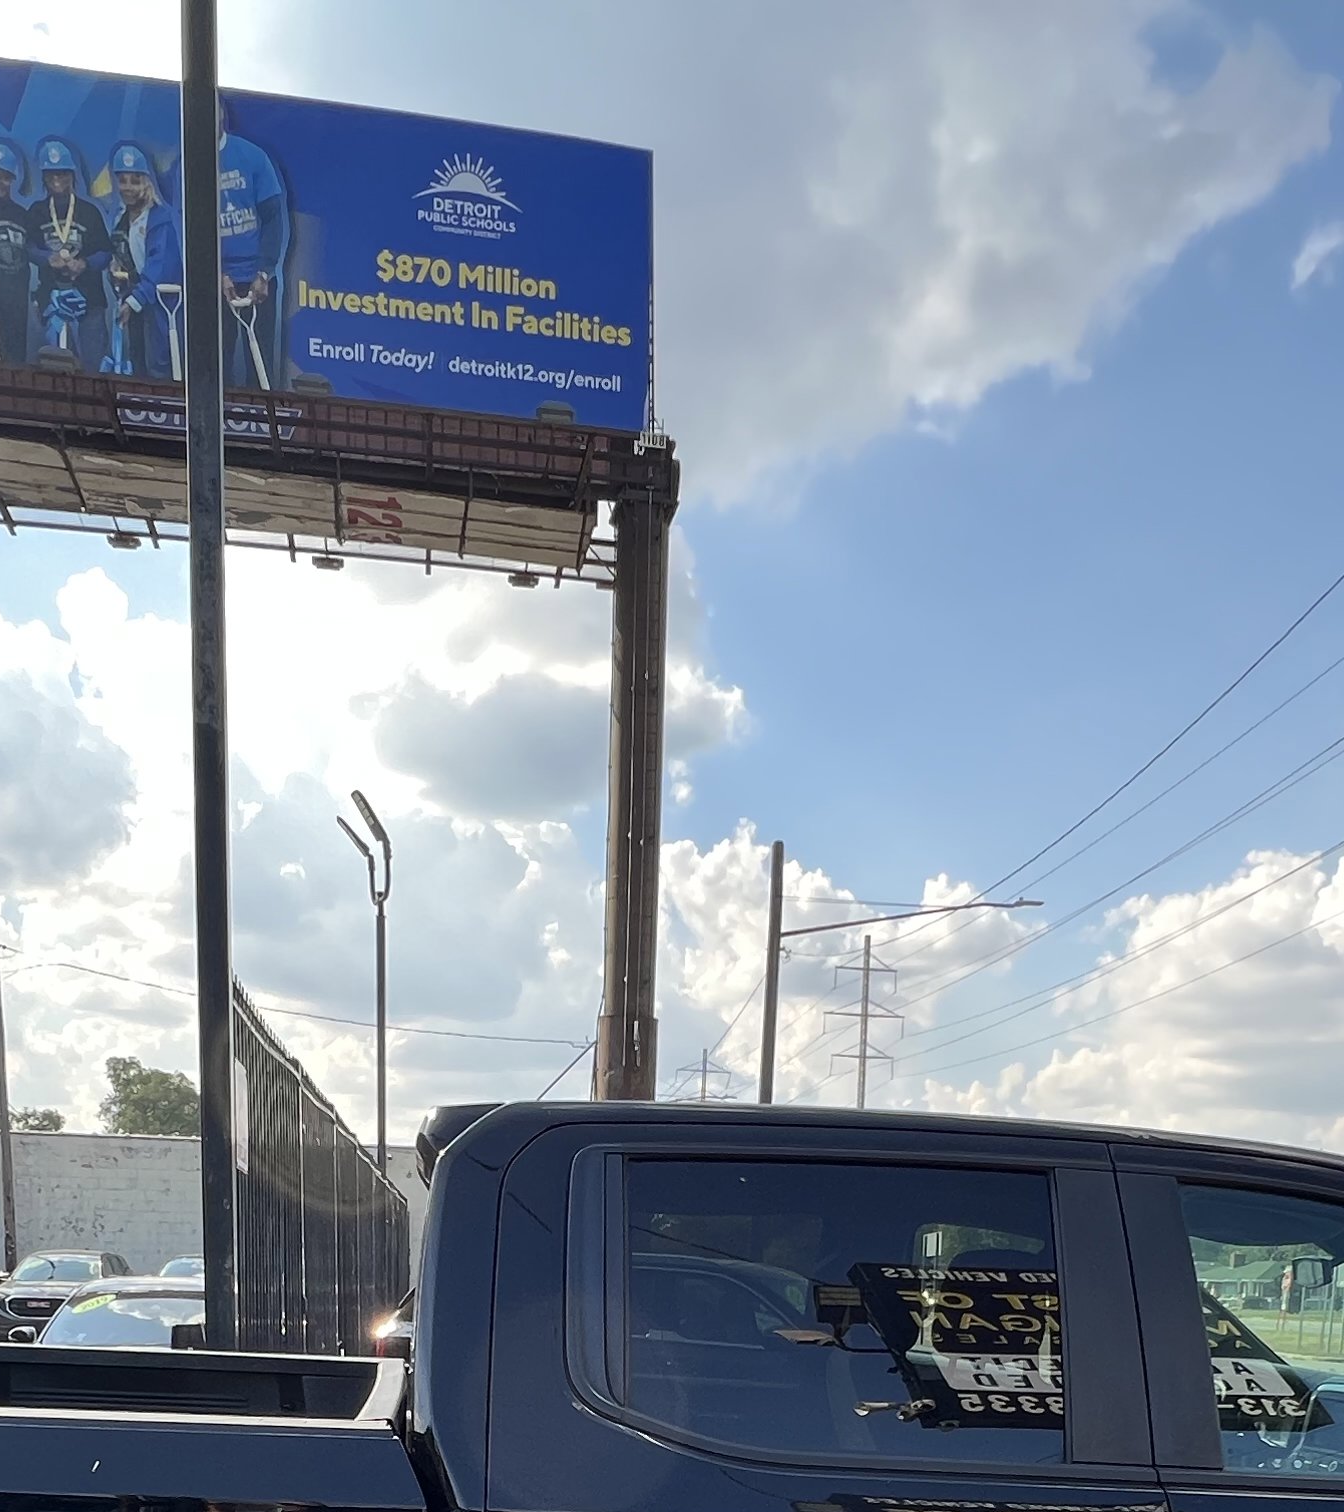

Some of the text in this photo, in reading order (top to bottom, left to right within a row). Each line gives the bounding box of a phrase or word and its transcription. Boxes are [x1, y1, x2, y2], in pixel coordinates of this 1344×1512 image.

[417, 210, 516, 233] PUBLIC SCHOOLS
[433, 197, 501, 219] DETROIT
[376, 249, 557, 300] $870 Million
[298, 280, 632, 347] Investment In Facilities
[308, 337, 622, 392] Enroll Today! detroitk12.org/enroll
